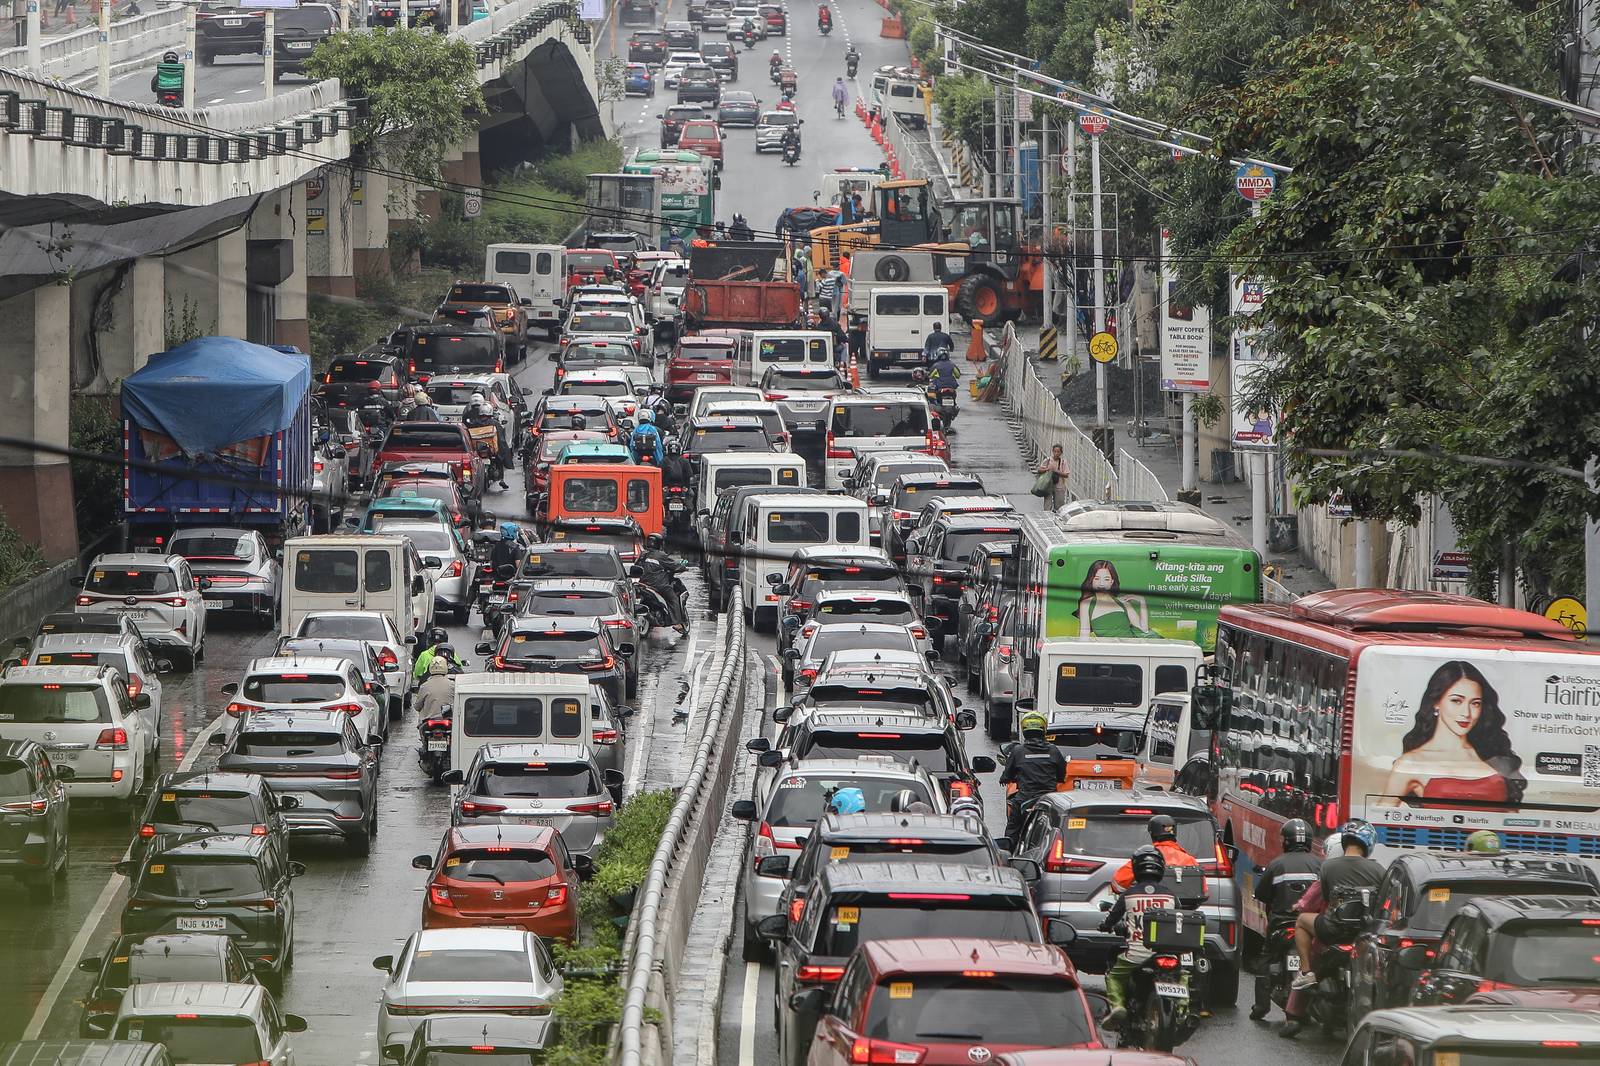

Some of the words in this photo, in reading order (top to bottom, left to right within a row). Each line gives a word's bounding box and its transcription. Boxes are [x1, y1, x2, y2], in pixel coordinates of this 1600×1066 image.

[1081, 116, 1108, 124] MMDA
[1238, 178, 1272, 187] MMDA
[1155, 562, 1205, 572] Kitang-kita
[1207, 564, 1224, 573] ang
[1164, 574, 1188, 583] Kutis
[1190, 574, 1212, 583] Silka
[1168, 584, 1188, 593] early
[1201, 585, 1211, 600] 7
[1209, 592, 1232, 602] days!
[1185, 602, 1217, 612] regular
[1514, 710, 1539, 719] Show
[1555, 712, 1573, 720] with
[1576, 713, 1592, 721] hair
[1547, 764, 1572, 772] SHOP!
[1467, 817, 1489, 825] Hairfix
